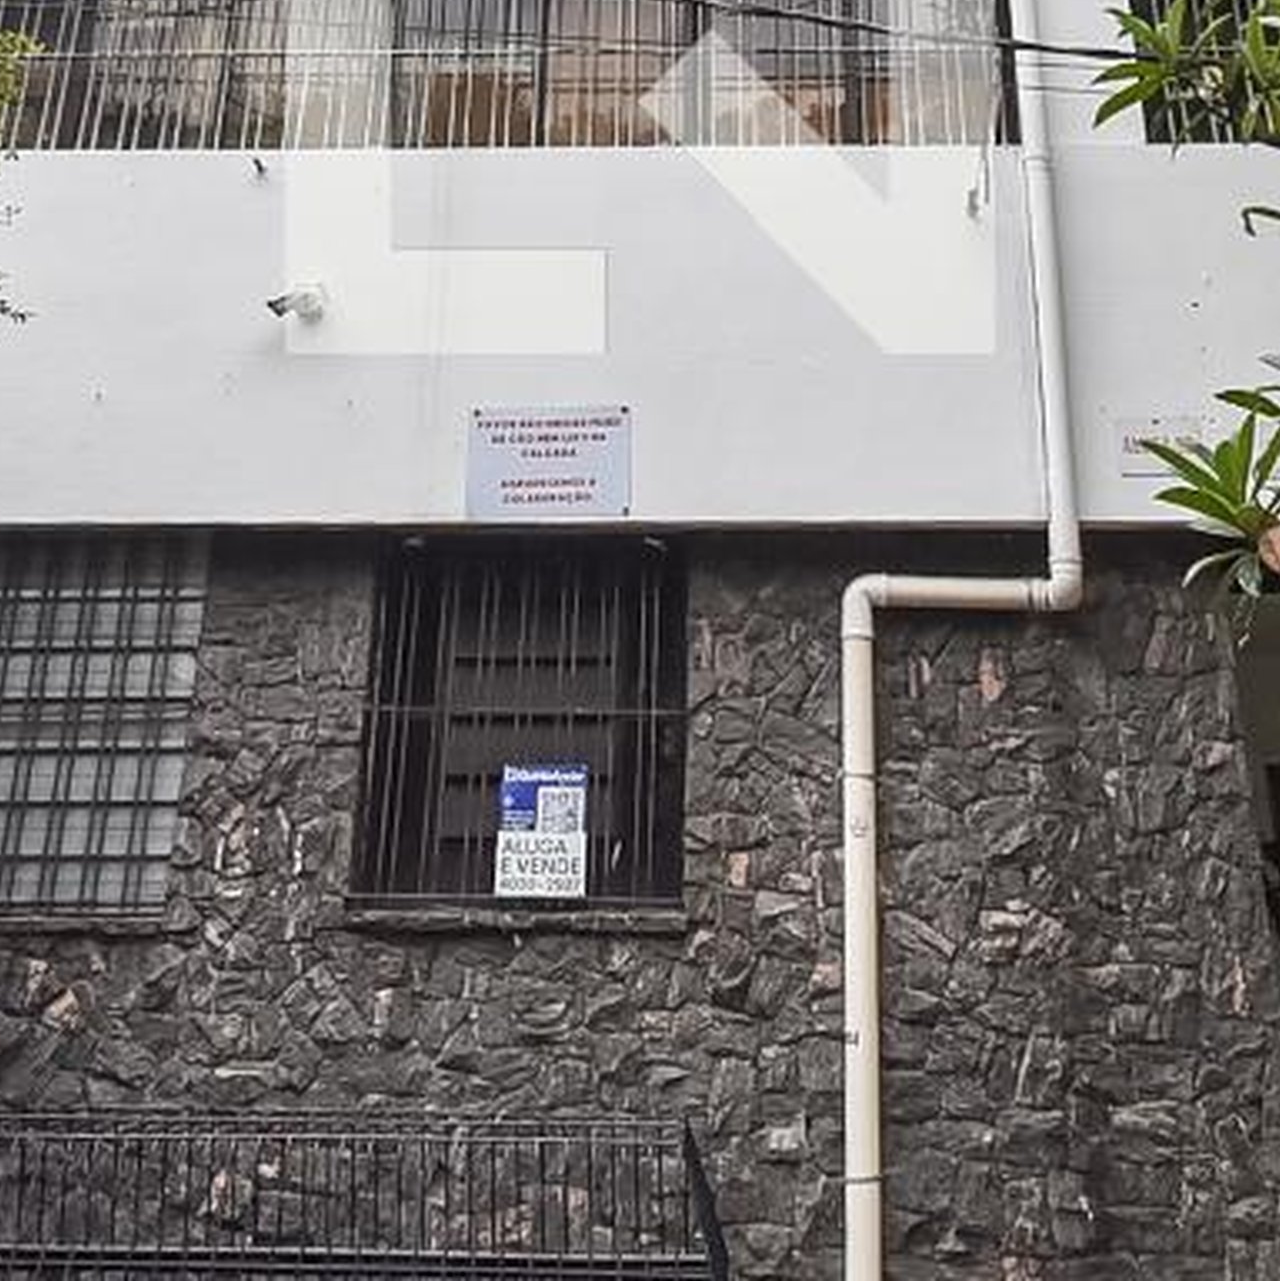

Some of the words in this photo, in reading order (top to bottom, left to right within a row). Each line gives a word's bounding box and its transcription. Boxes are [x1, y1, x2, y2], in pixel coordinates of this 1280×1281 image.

[501, 837, 567, 855] ALUGA
[501, 857, 511, 875] E
[517, 857, 581, 875] VENDE
